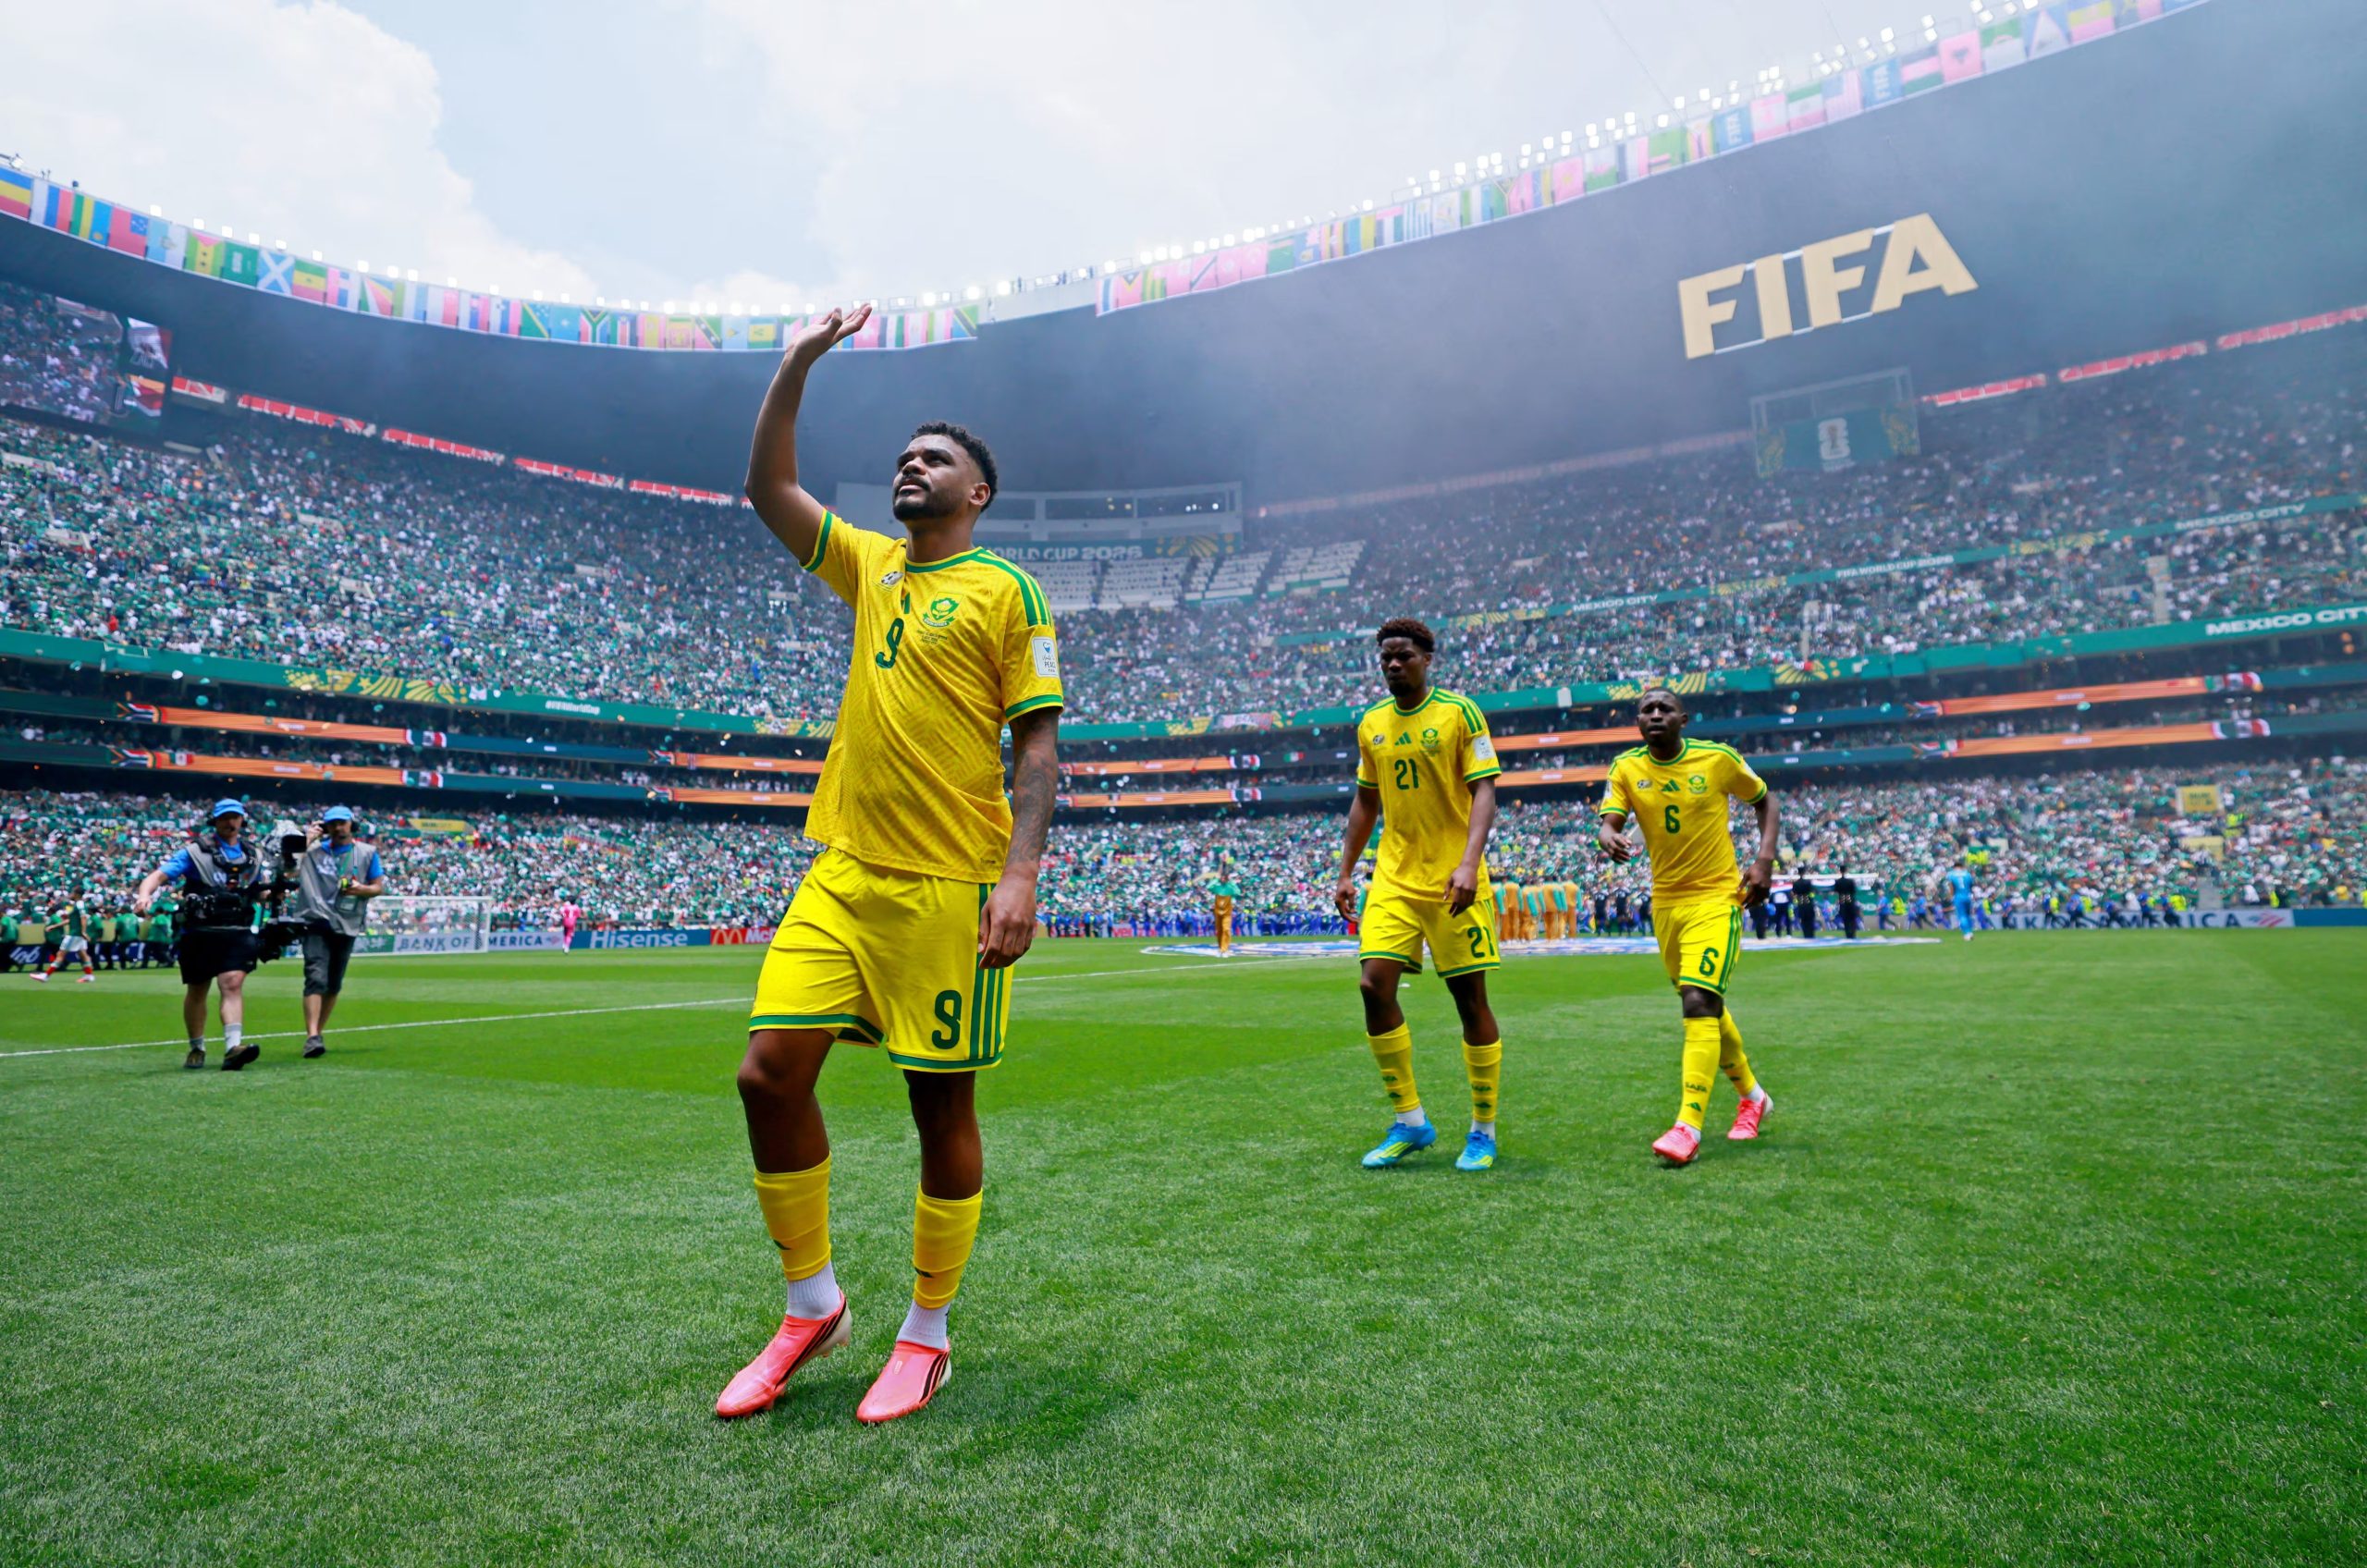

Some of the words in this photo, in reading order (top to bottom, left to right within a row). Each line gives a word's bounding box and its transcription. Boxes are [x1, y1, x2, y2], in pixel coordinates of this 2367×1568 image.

[1678, 213, 1979, 360] FIFA
[2175, 512, 2254, 530] MEXICO
[2256, 504, 2305, 519] CITY
[991, 546, 1040, 560] ORLD
[1043, 547, 1078, 560] CUP
[1859, 563, 1895, 575] WORLD
[1896, 560, 1917, 570] CUP
[1573, 599, 1625, 612] MEXICO
[1627, 594, 1658, 605] CITY
[2205, 612, 2312, 636] MEXICO
[2315, 606, 2367, 623] CIT
[876, 618, 904, 668] 9
[1394, 758, 1419, 790] 21
[1665, 804, 1681, 834] 6
[399, 937, 446, 951] BANK
[451, 937, 471, 948] OF
[483, 935, 543, 947] MERICA
[589, 930, 689, 949] Hisense
[1467, 925, 1495, 959] 21
[1699, 947, 1720, 977] 6
[931, 989, 963, 1050] 9
